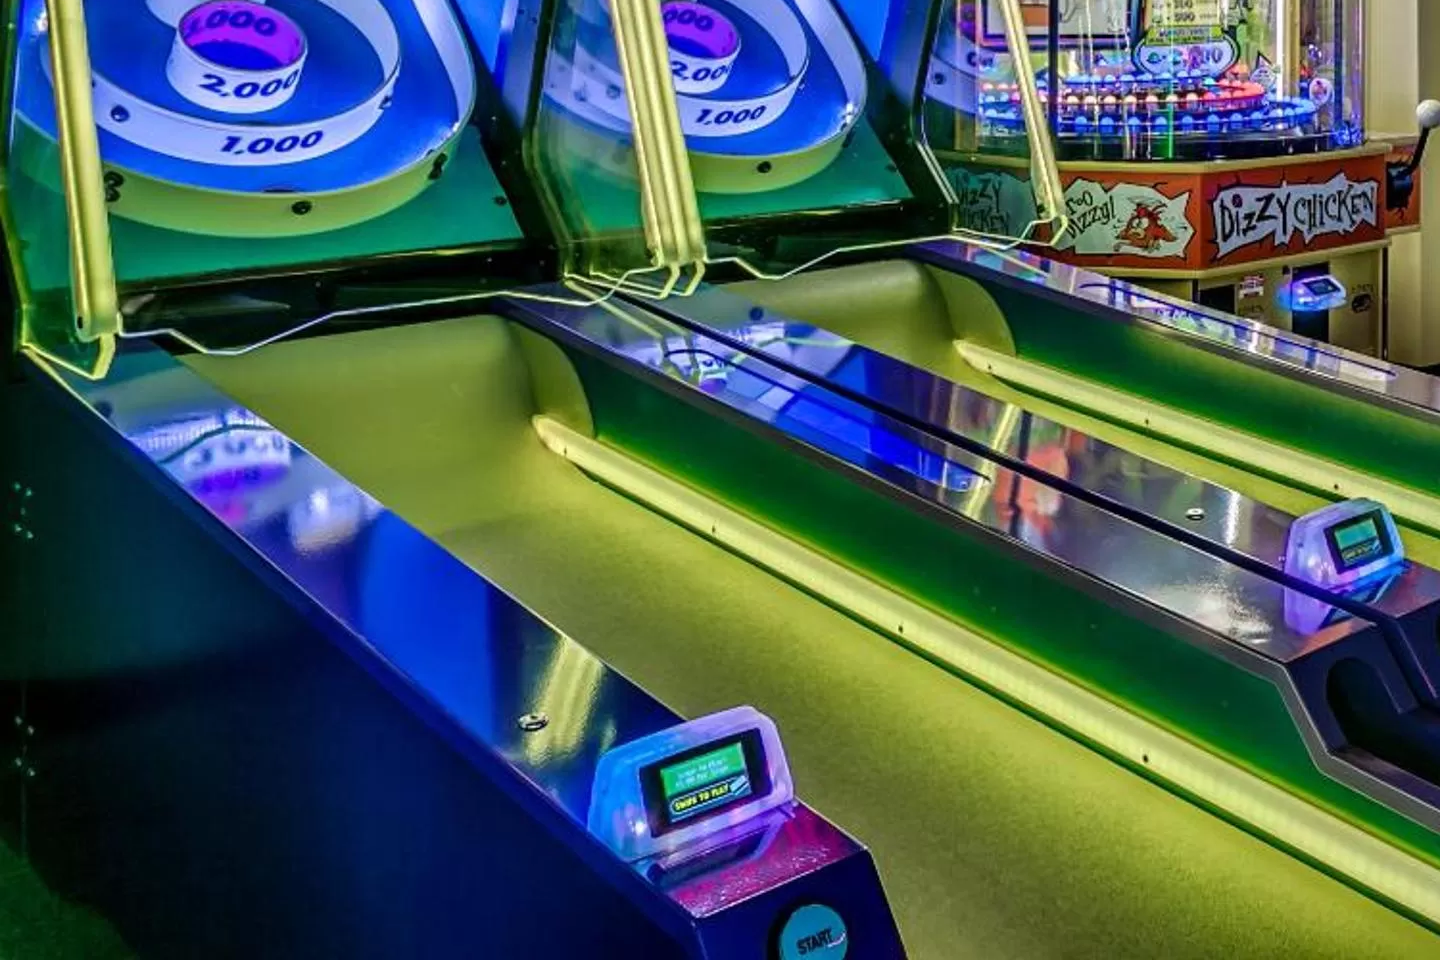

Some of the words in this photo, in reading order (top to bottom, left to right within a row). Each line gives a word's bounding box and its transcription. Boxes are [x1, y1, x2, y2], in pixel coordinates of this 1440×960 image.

[199, 69, 300, 99] 2,000
[695, 105, 767, 126] 1,000
[219, 130, 323, 155] 1,000
[796, 926, 833, 955] START
